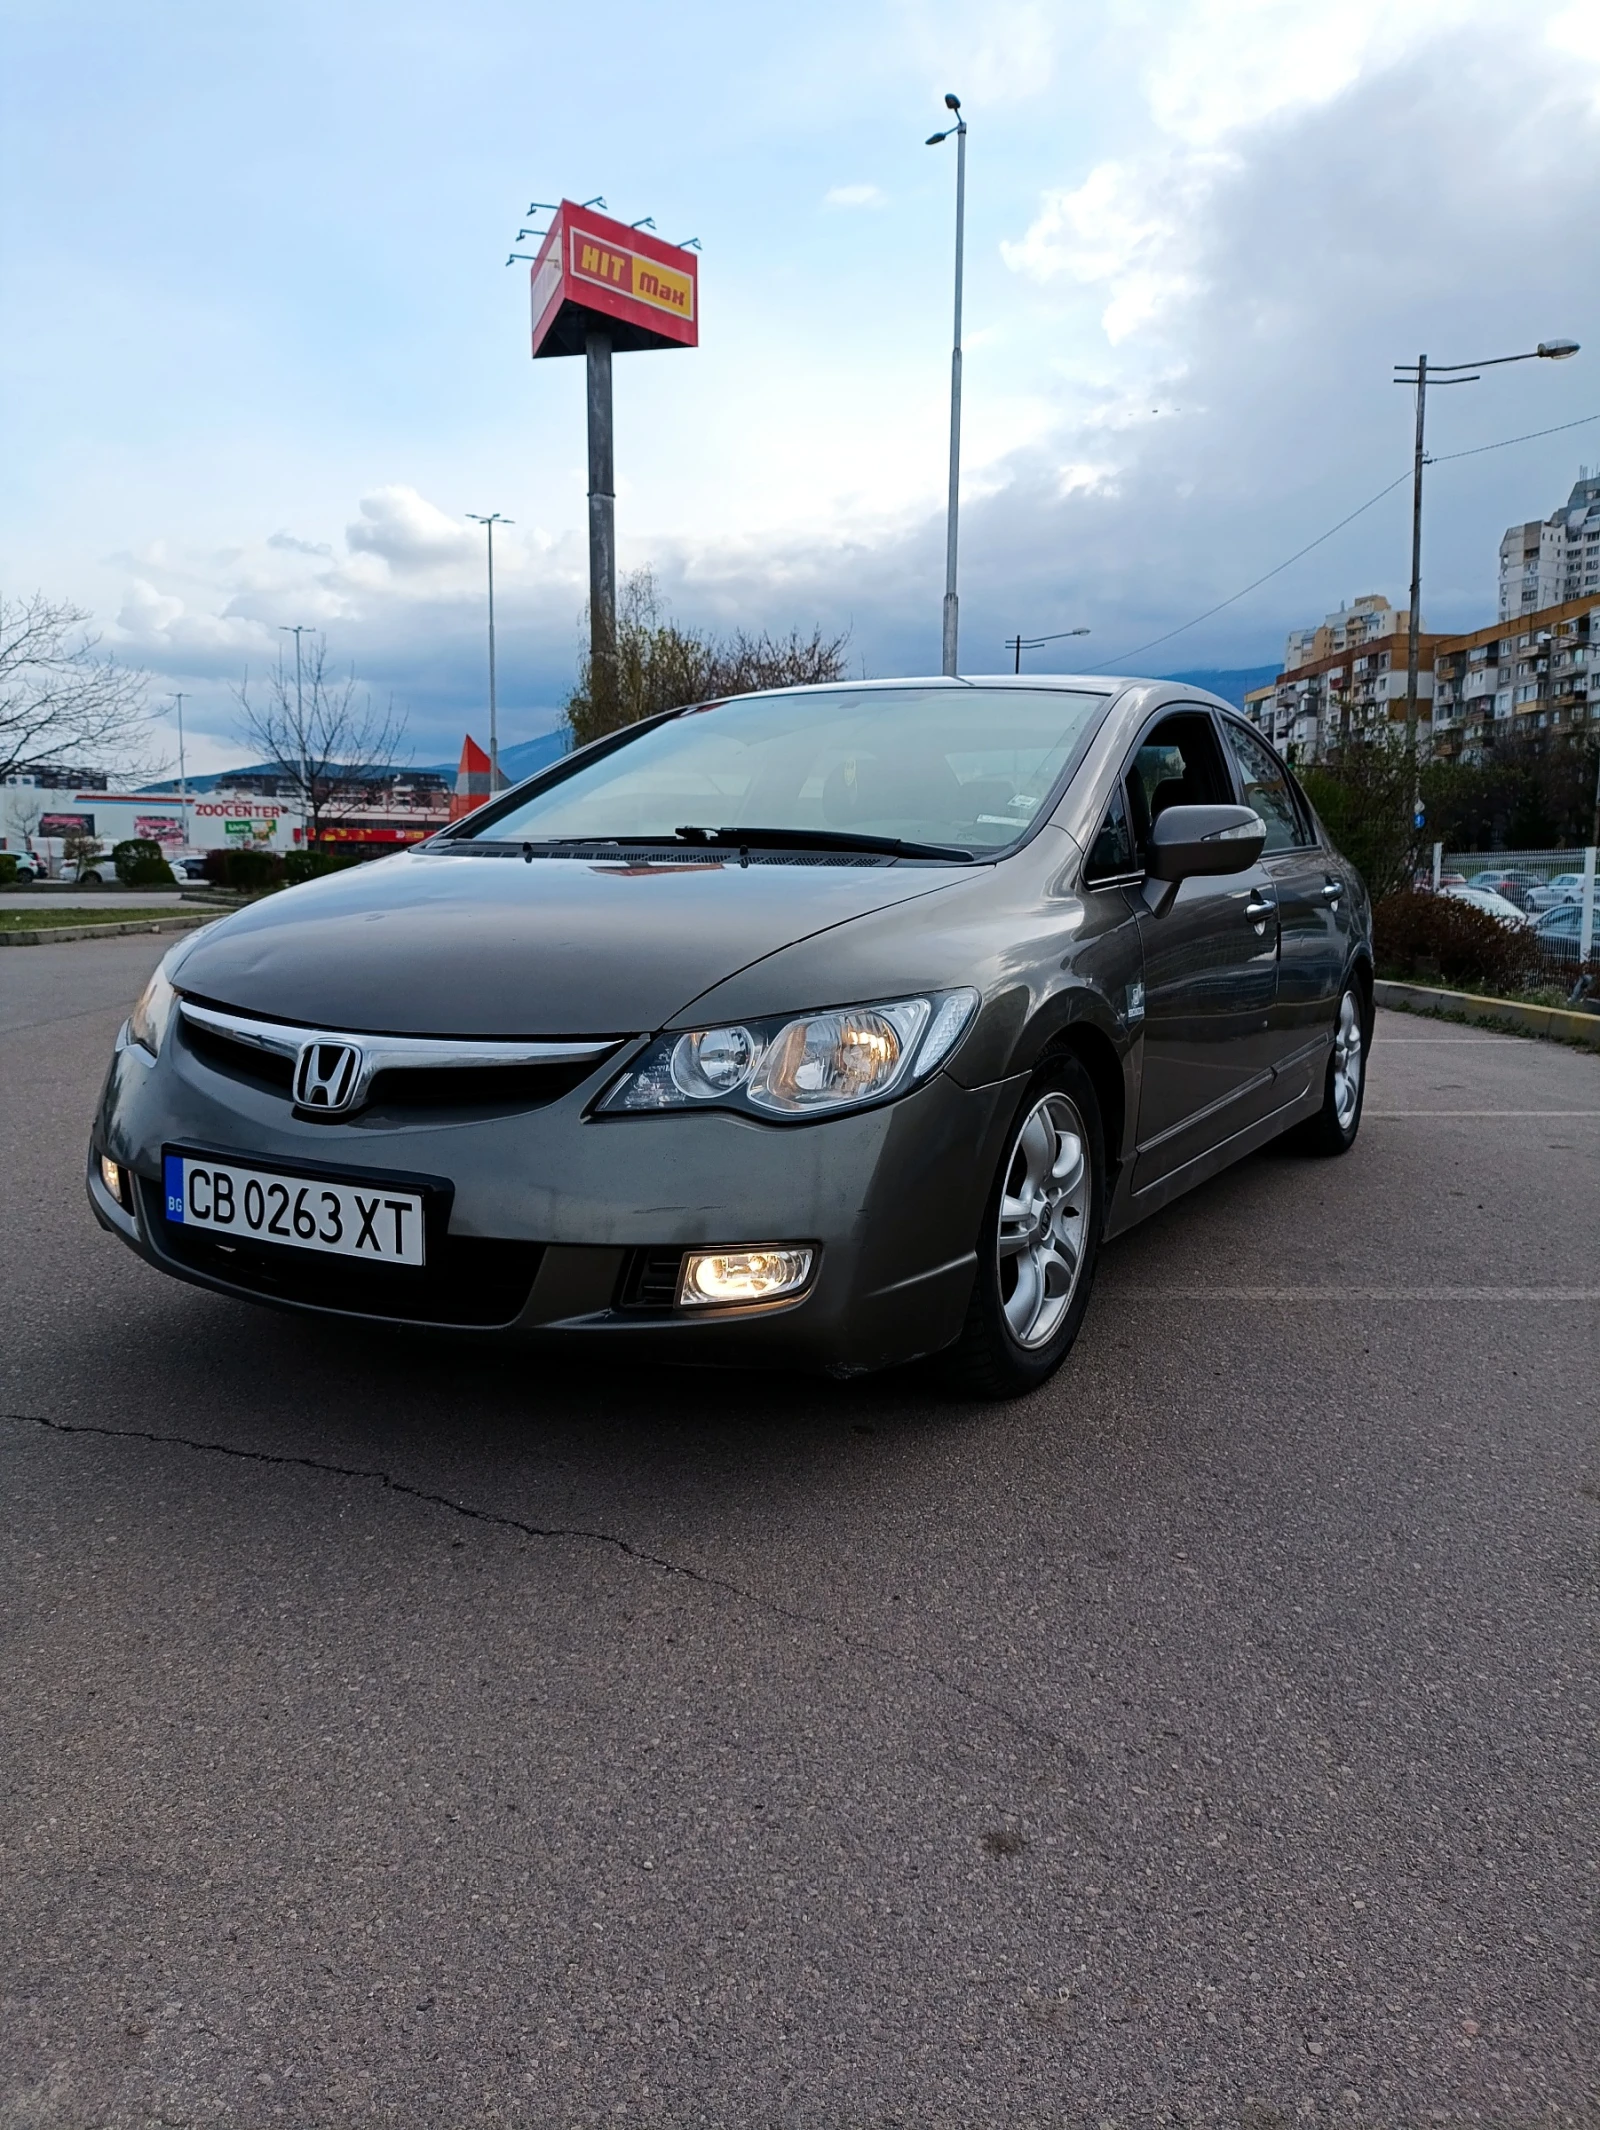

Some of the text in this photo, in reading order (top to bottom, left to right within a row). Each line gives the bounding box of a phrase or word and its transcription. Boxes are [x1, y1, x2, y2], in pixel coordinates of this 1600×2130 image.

[581, 244, 625, 282] HIT
[195, 804, 280, 818] ZOOCENTER
[168, 1196, 183, 1213] BG
[189, 1168, 413, 1255] CB 0263 XT
